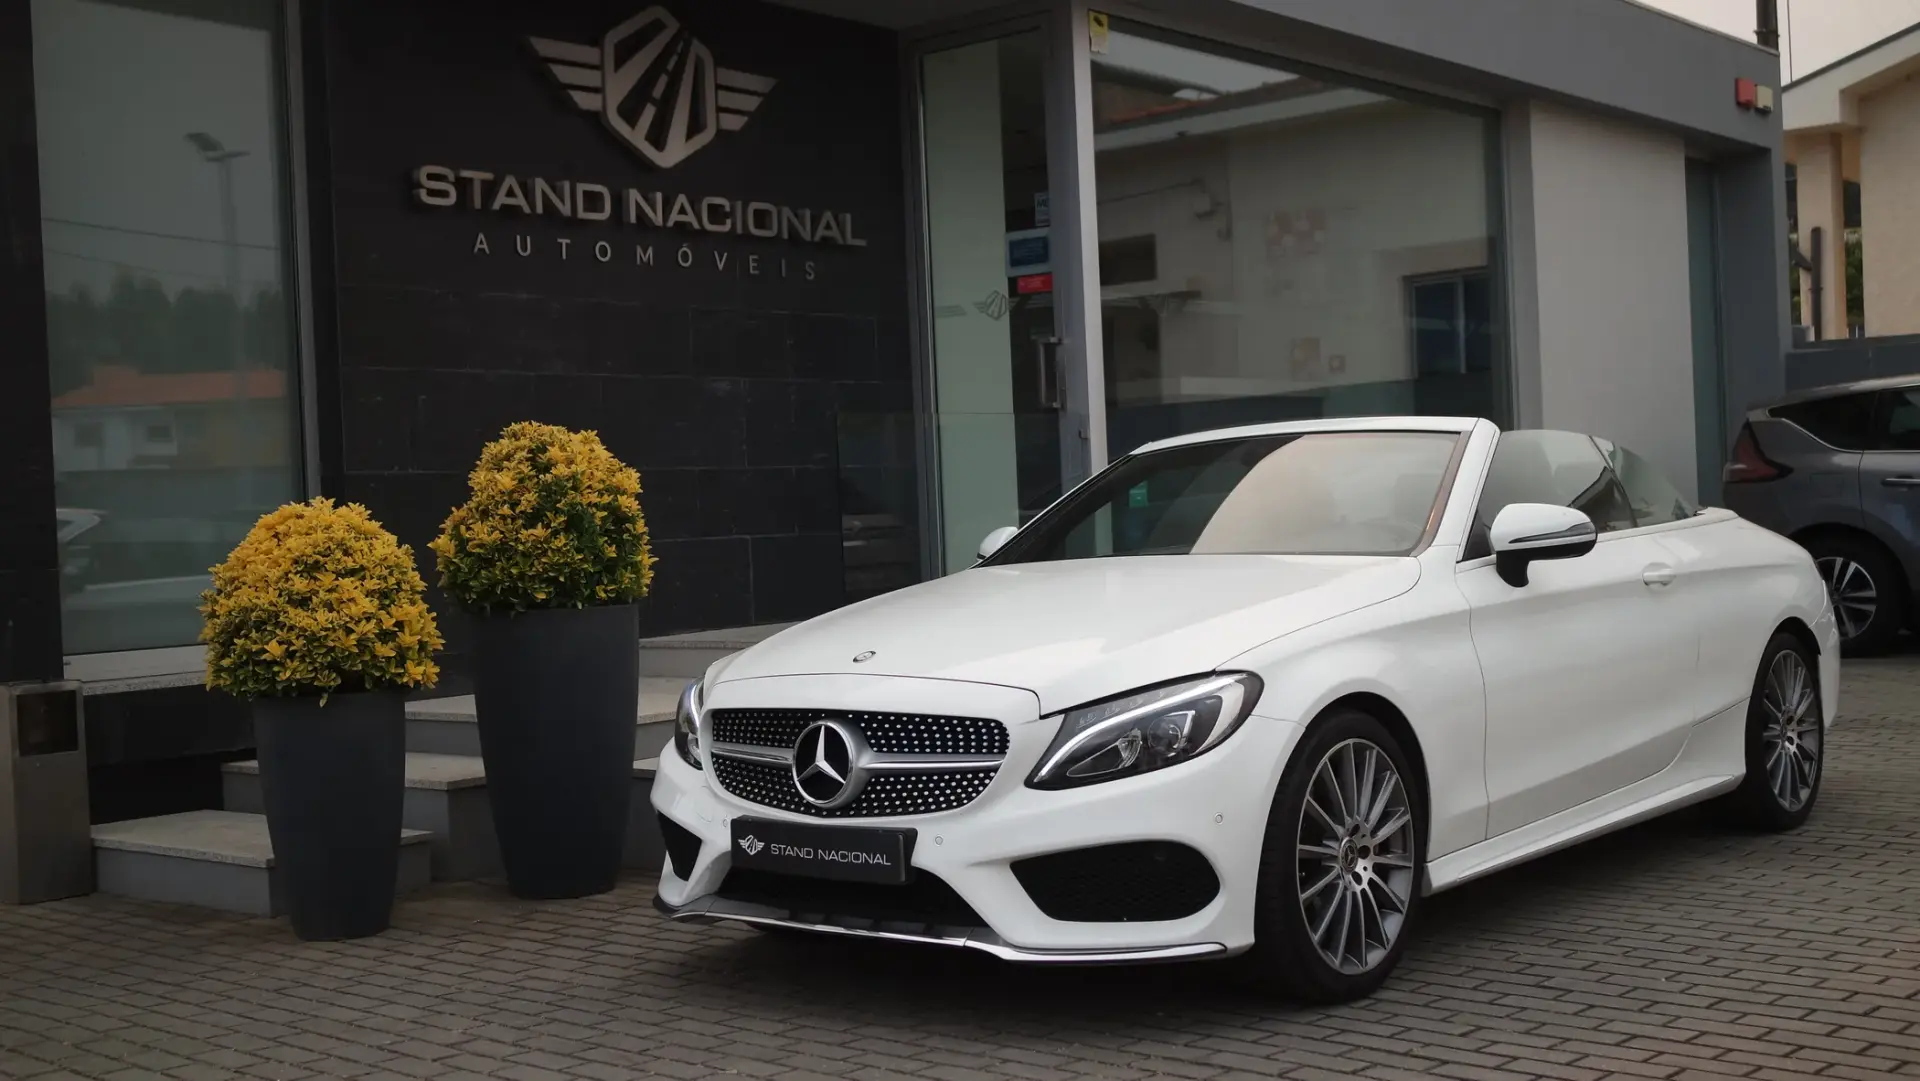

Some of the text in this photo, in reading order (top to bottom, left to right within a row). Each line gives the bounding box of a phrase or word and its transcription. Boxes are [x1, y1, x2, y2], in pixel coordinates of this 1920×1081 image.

[418, 165, 867, 247] STAND NACIONAL
[473, 232, 816, 280] AUTOMÓVEIS
[770, 843, 892, 866] STAND NACIONAL
